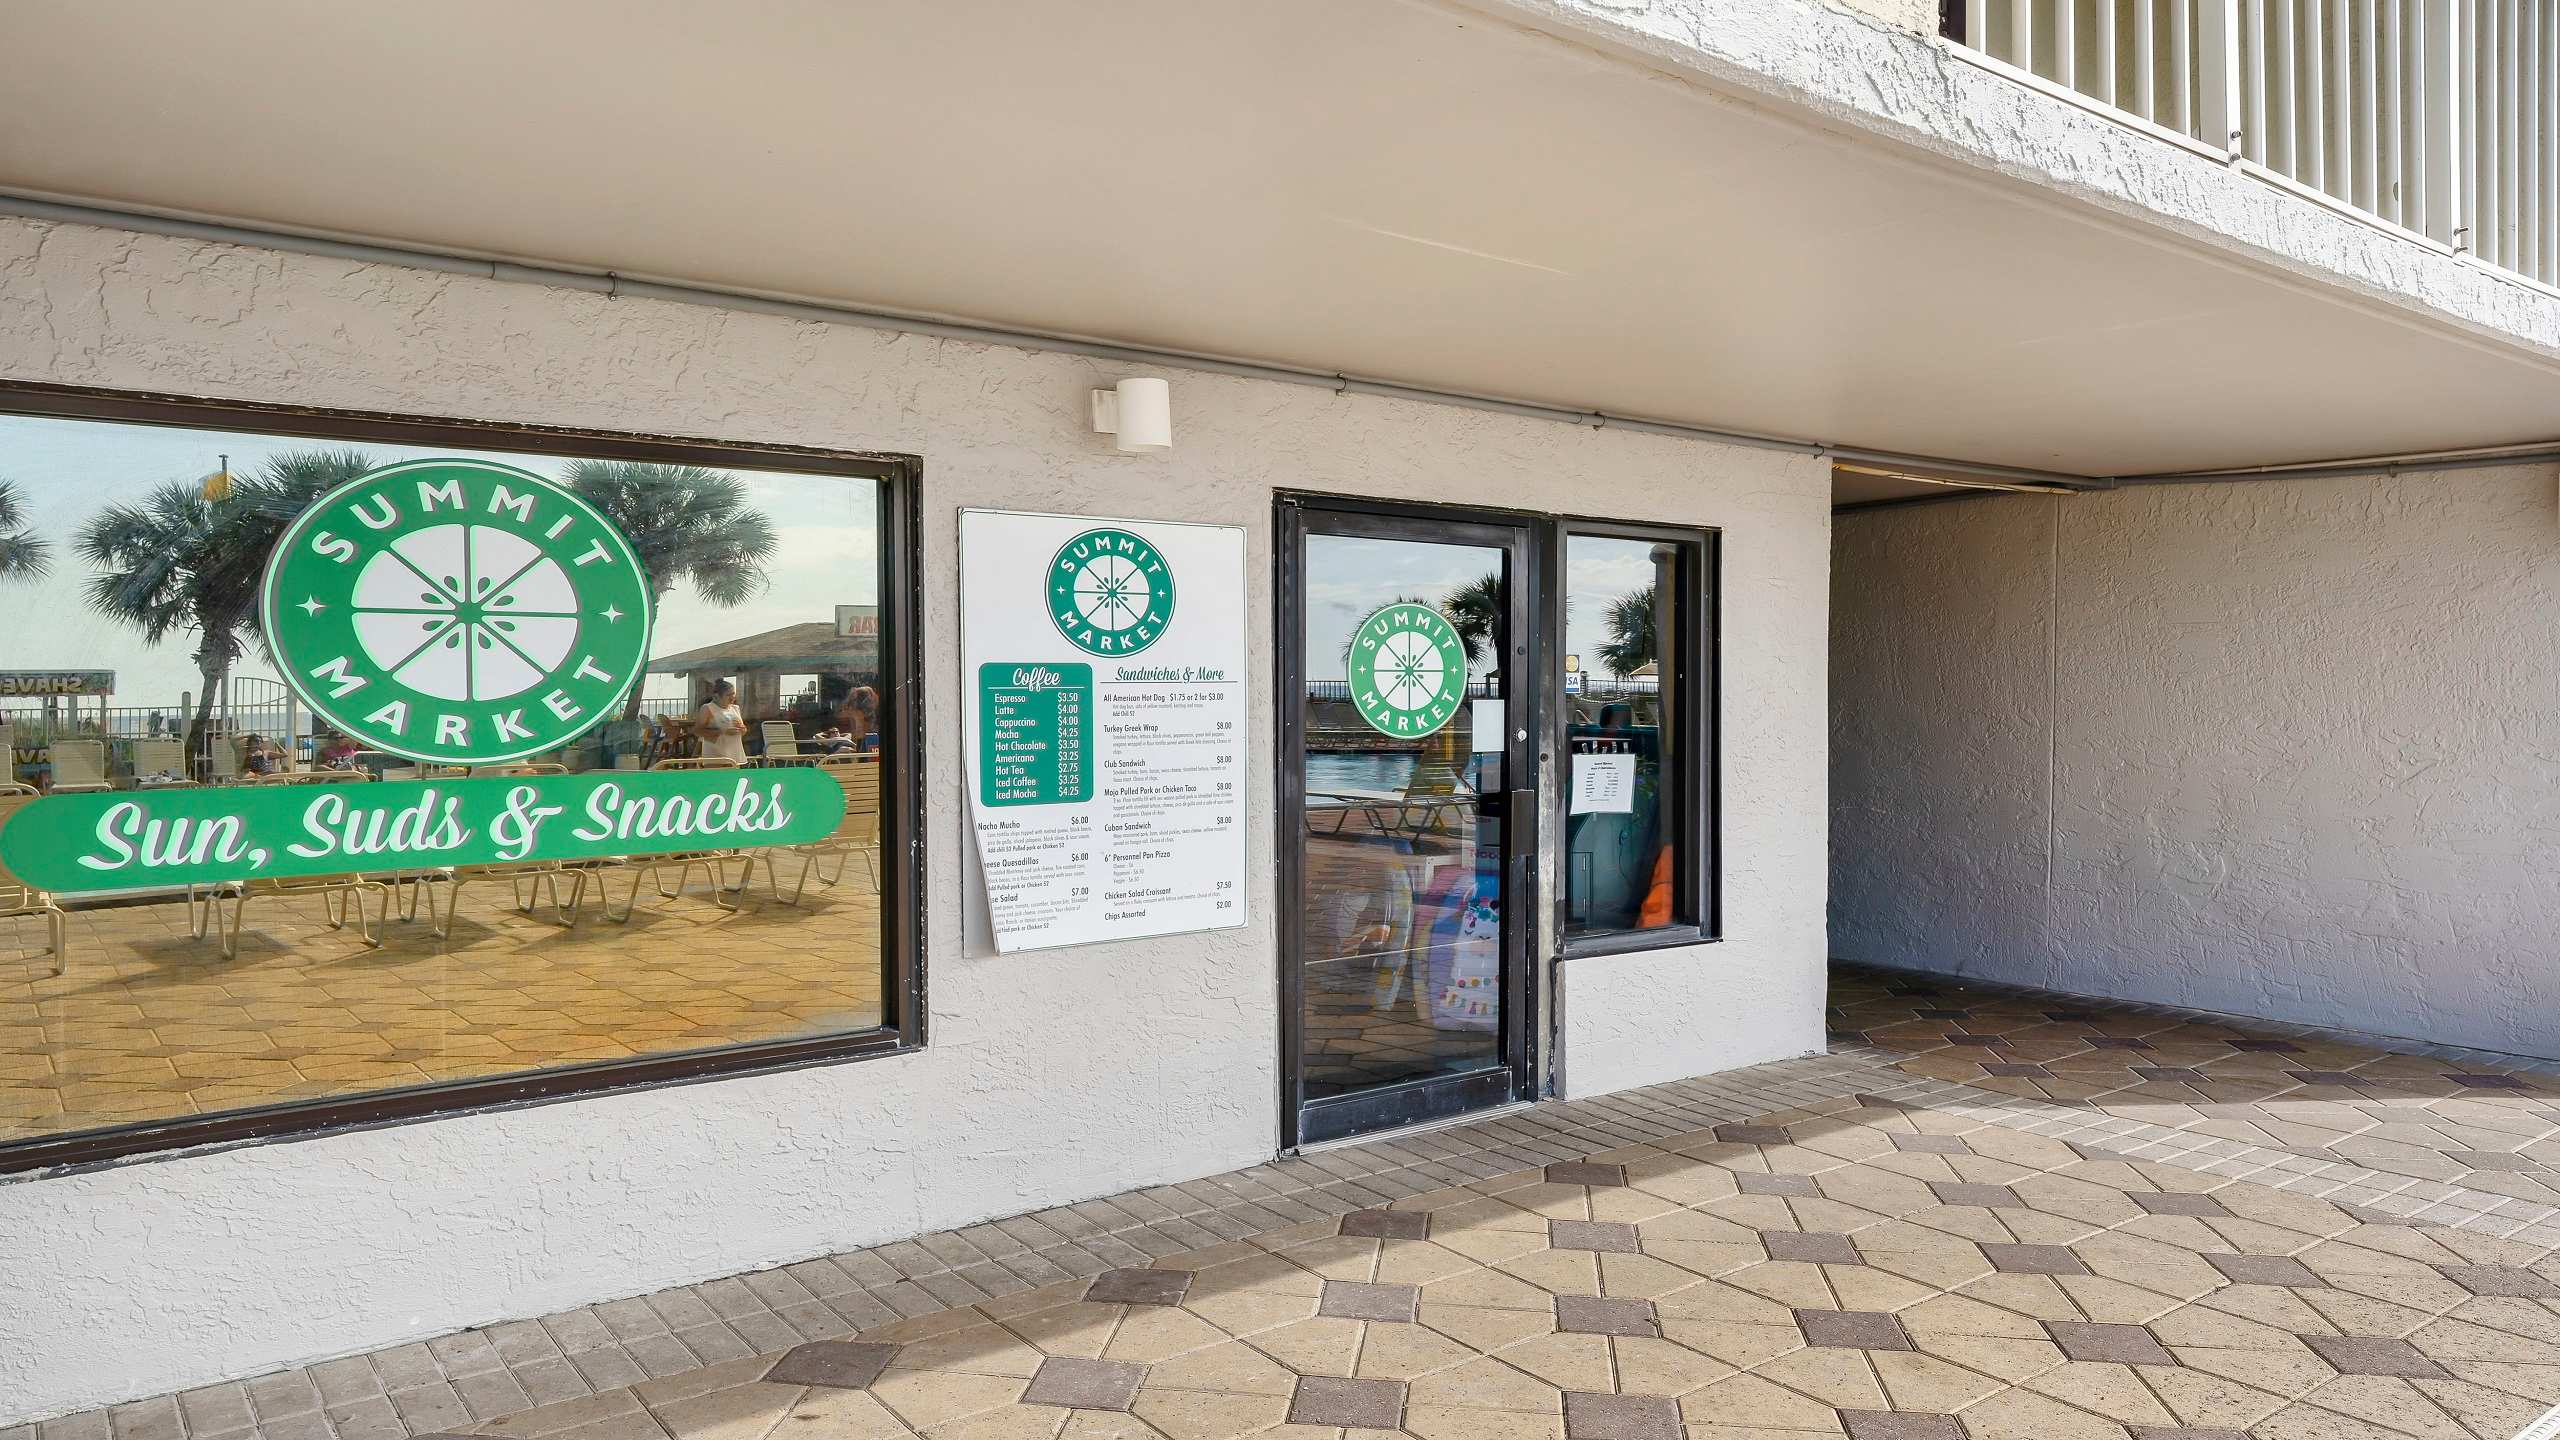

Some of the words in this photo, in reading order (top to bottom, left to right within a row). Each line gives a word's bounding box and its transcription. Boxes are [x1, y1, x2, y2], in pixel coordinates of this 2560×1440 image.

[311, 480, 613, 567] SUMMIT
[1061, 536, 1161, 573] SUMMIT
[1061, 611, 1162, 649] MARKET
[1362, 612, 1455, 651] SUMMIT
[1013, 667, 1060, 692] Coffee
[1115, 666, 1180, 681] Sandwiches
[1183, 666, 1194, 683] &
[1196, 666, 1224, 680] More
[1567, 676, 1579, 686] SA
[310, 655, 613, 747] MARKET
[995, 694, 1025, 704] Espresso
[1057, 693, 1078, 702] $3.50
[1113, 694, 1140, 702] American
[1142, 693, 1152, 701] Hot
[1154, 693, 1165, 702] Dog
[1170, 693, 1185, 701] $1.75
[1208, 693, 1223, 701] $3.00
[995, 706, 1014, 714] Latte
[1057, 704, 1078, 714] $4.00
[1362, 688, 1455, 731] MARKET
[995, 717, 1036, 729] Cappuccino
[1058, 716, 1078, 726] $4.00
[1058, 728, 1078, 738] $4.25
[1104, 725, 1122, 733] Turkey
[1125, 723, 1141, 732] Greek
[1143, 724, 1158, 732] Wrap
[995, 730, 1019, 739] Mocha
[996, 742, 1008, 751] Hot
[1011, 741, 1046, 750] Chocolate
[1058, 740, 1078, 749] $3.50
[996, 754, 1034, 763] Americano
[1058, 751, 1078, 761] $3.25
[1058, 763, 1078, 773] $2.75
[1104, 760, 1117, 768] Club
[1119, 758, 1145, 767] Sandwich
[996, 766, 1009, 775] Hot
[1011, 765, 1024, 774] Tea
[996, 778, 1010, 787] Iced
[1013, 777, 1036, 786] Coffee
[1059, 775, 1078, 785] $3.25
[996, 790, 1010, 799] Iced
[1013, 789, 1037, 798] Mocha
[1059, 787, 1078, 797] $4.25
[1104, 788, 1118, 797] Mojo
[1140, 786, 1153, 794] Pork
[1162, 785, 1183, 793] Chicken
[77, 801, 268, 870] Sun,
[286, 789, 470, 857] Suds
[489, 786, 562, 860] &
[572, 778, 791, 842] Snacks
[1071, 816, 1088, 825] $6.00
[978, 822, 997, 831] Nacho
[1000, 821, 1020, 829] Mucho
[1105, 824, 1122, 832] Cuban
[1124, 821, 1151, 830] Sandwich
[1002, 858, 1039, 867] Quesadillas
[1071, 853, 1088, 862] $6.00
[1071, 887, 1088, 897] $7.00
[1105, 891, 1126, 900] Chicken
[1128, 889, 1144, 898] Salad
[1146, 888, 1171, 896] Croissant
[1000, 894, 1018, 903] Salad
[1217, 901, 1232, 909] $2.00
[1105, 912, 1120, 921] Chips
[1122, 909, 1146, 919] Assorted
